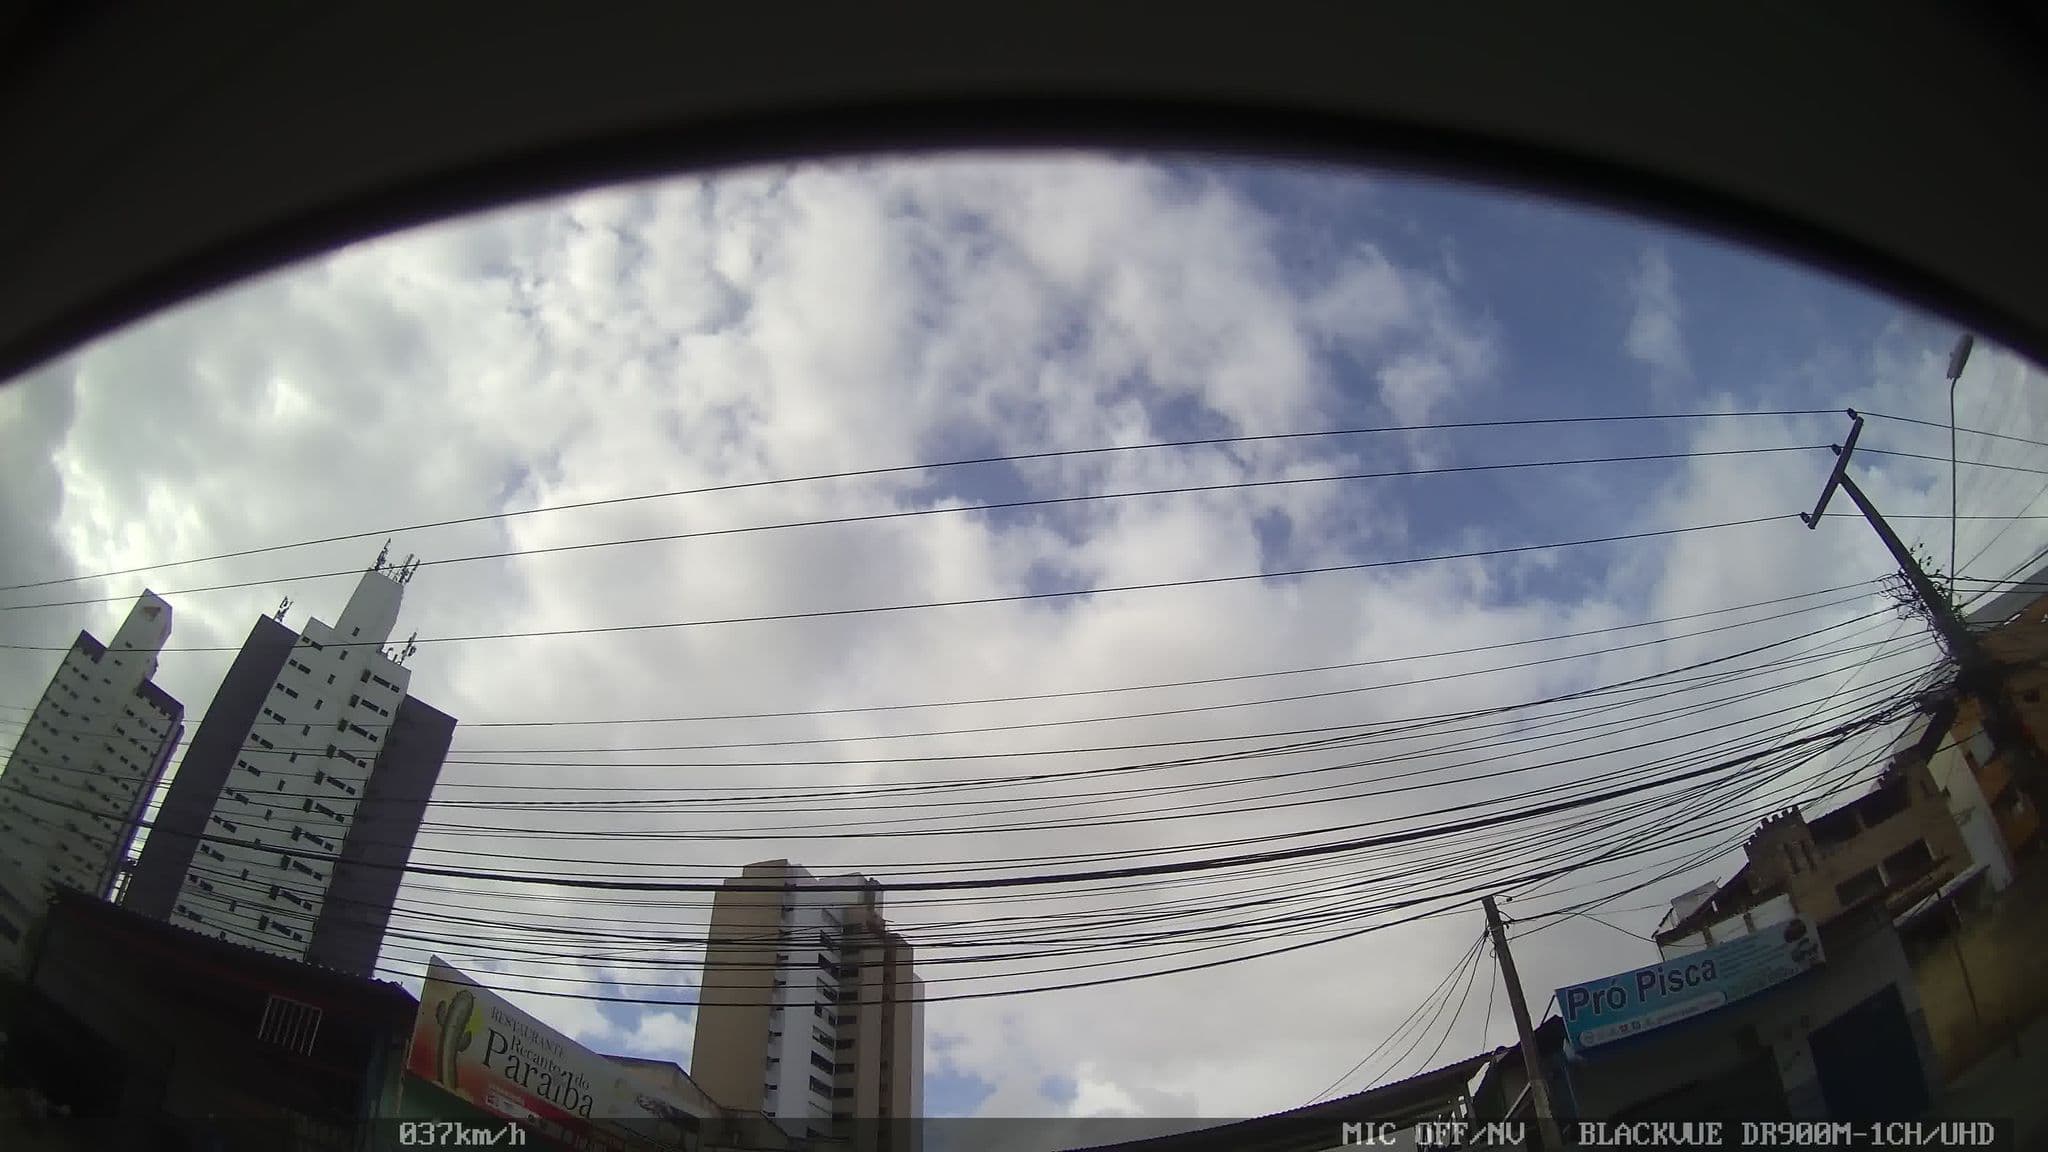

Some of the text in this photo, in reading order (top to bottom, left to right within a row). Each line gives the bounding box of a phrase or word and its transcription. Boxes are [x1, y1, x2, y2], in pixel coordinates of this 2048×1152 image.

[1567, 980, 1627, 1022] Pró
[1636, 958, 1718, 1002] Pisca
[491, 1006, 565, 1058] RESTAURANTE
[482, 1027, 593, 1120] Paraíba
